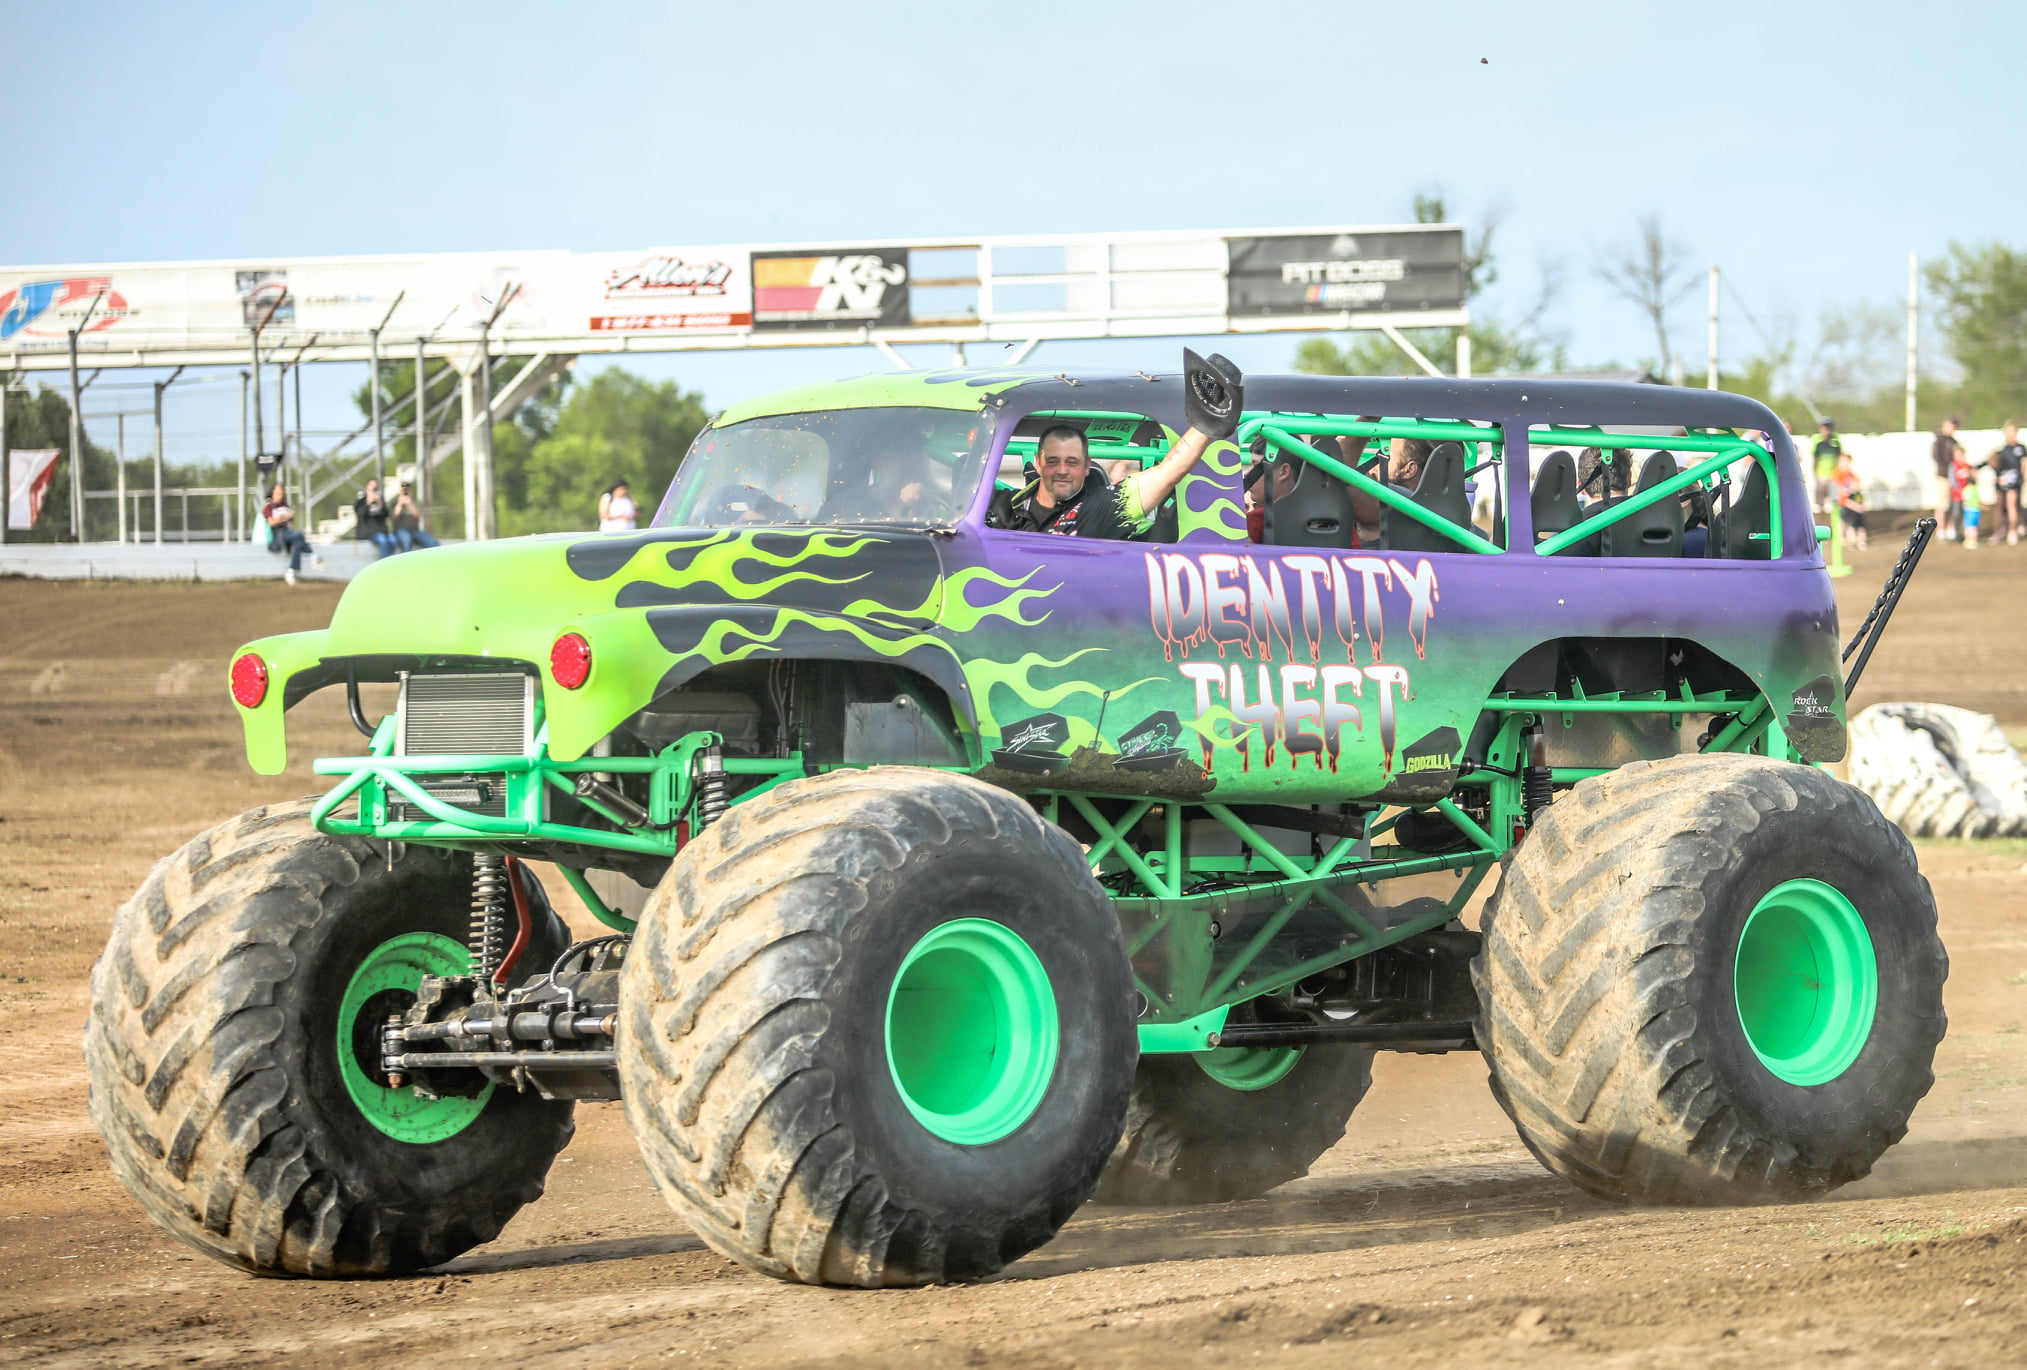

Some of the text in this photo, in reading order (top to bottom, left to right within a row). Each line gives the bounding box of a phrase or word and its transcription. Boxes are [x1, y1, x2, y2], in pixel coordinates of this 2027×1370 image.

[1145, 552, 1439, 663] IDENTITY
[1178, 661, 1409, 779] THEFT
[1805, 705, 1829, 714] STAR
[1405, 753, 1452, 774] GODZILLA
